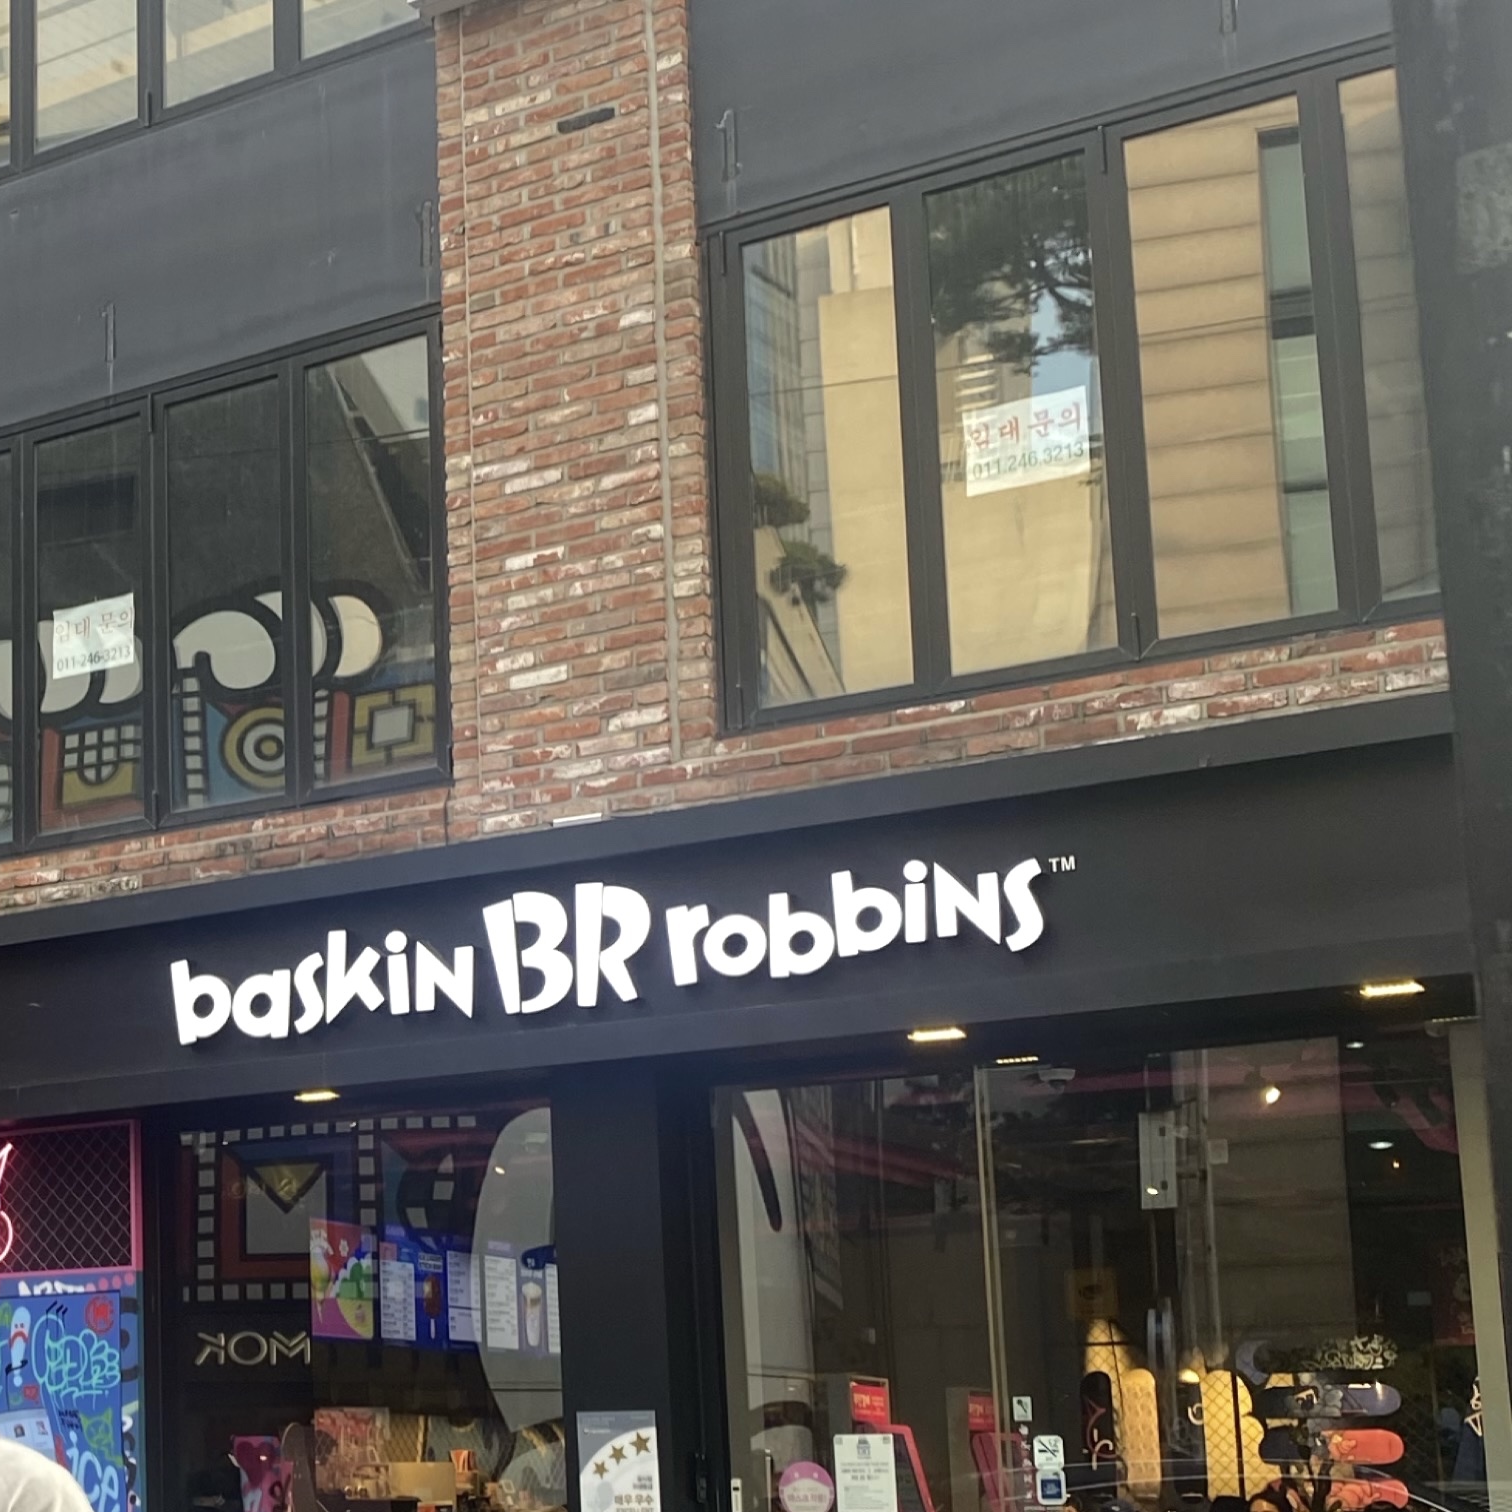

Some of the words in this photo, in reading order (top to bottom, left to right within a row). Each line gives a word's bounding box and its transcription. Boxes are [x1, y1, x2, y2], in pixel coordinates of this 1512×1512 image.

[970, 416, 1019, 449] 임대
[1028, 402, 1081, 437] 문의
[56, 616, 90, 643] 임대
[100, 607, 133, 634] 문의
[481, 881, 652, 1016] BR
